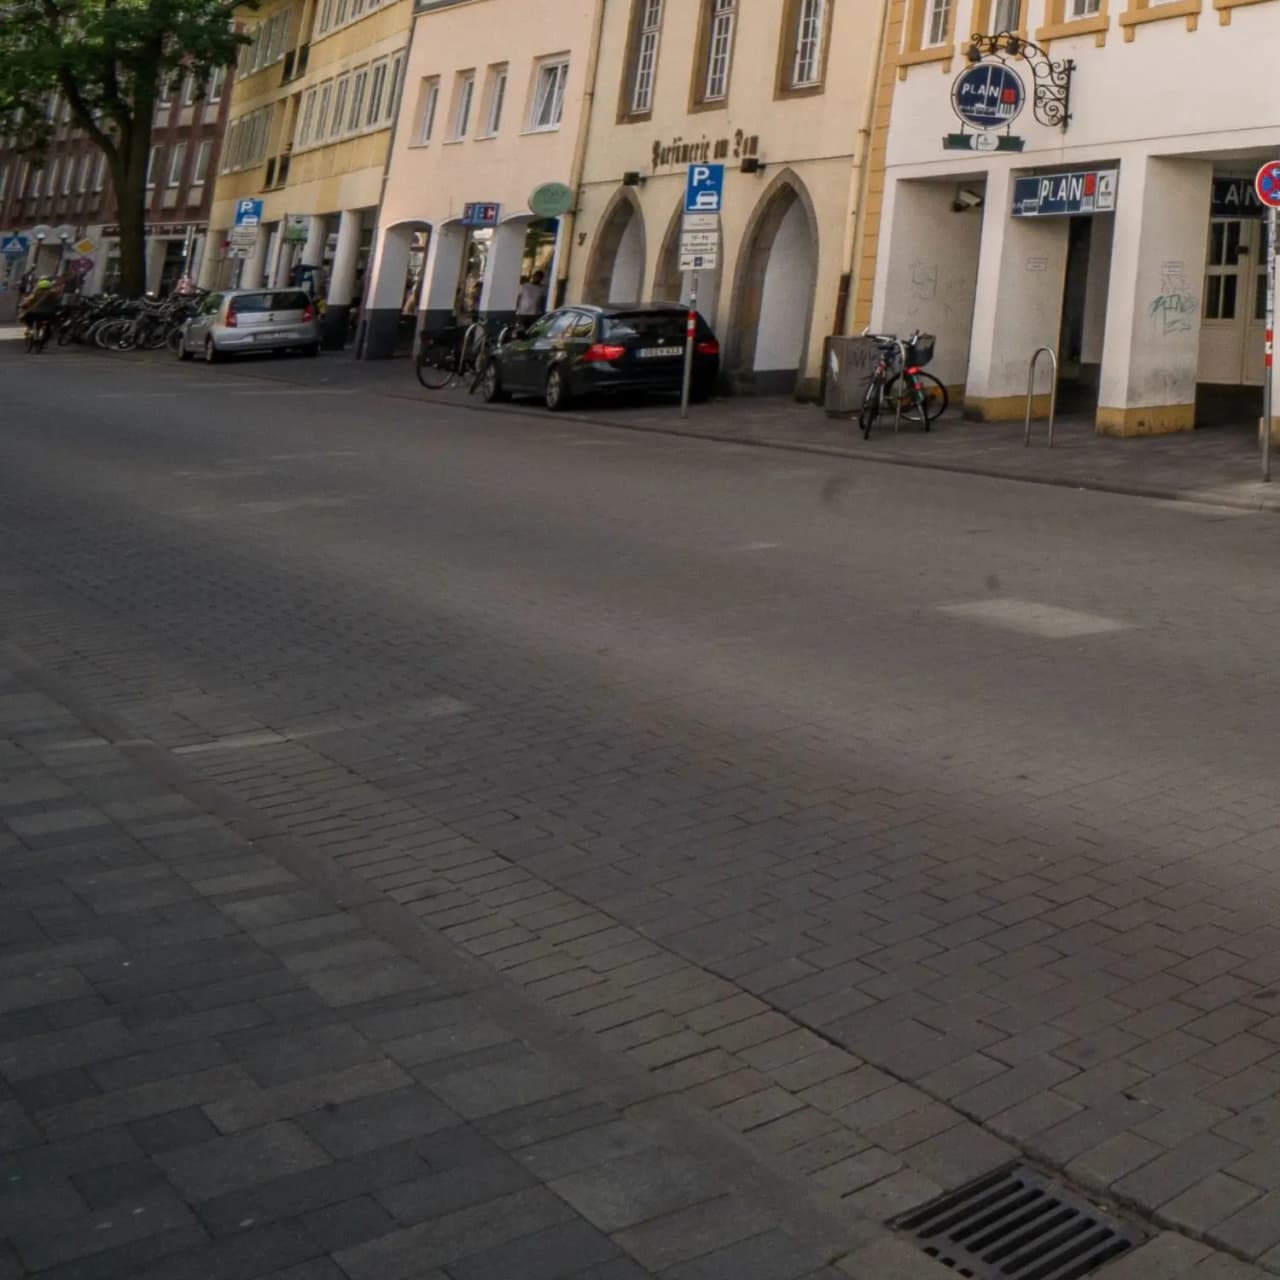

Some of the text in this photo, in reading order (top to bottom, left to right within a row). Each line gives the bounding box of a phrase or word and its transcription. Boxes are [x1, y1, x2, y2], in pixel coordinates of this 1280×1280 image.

[961, 83, 1000, 98] PLAN
[693, 167, 710, 187] P
[1039, 177, 1083, 206] PLAN
[1213, 183, 1261, 206] LAN
[240, 201, 253, 213] P
